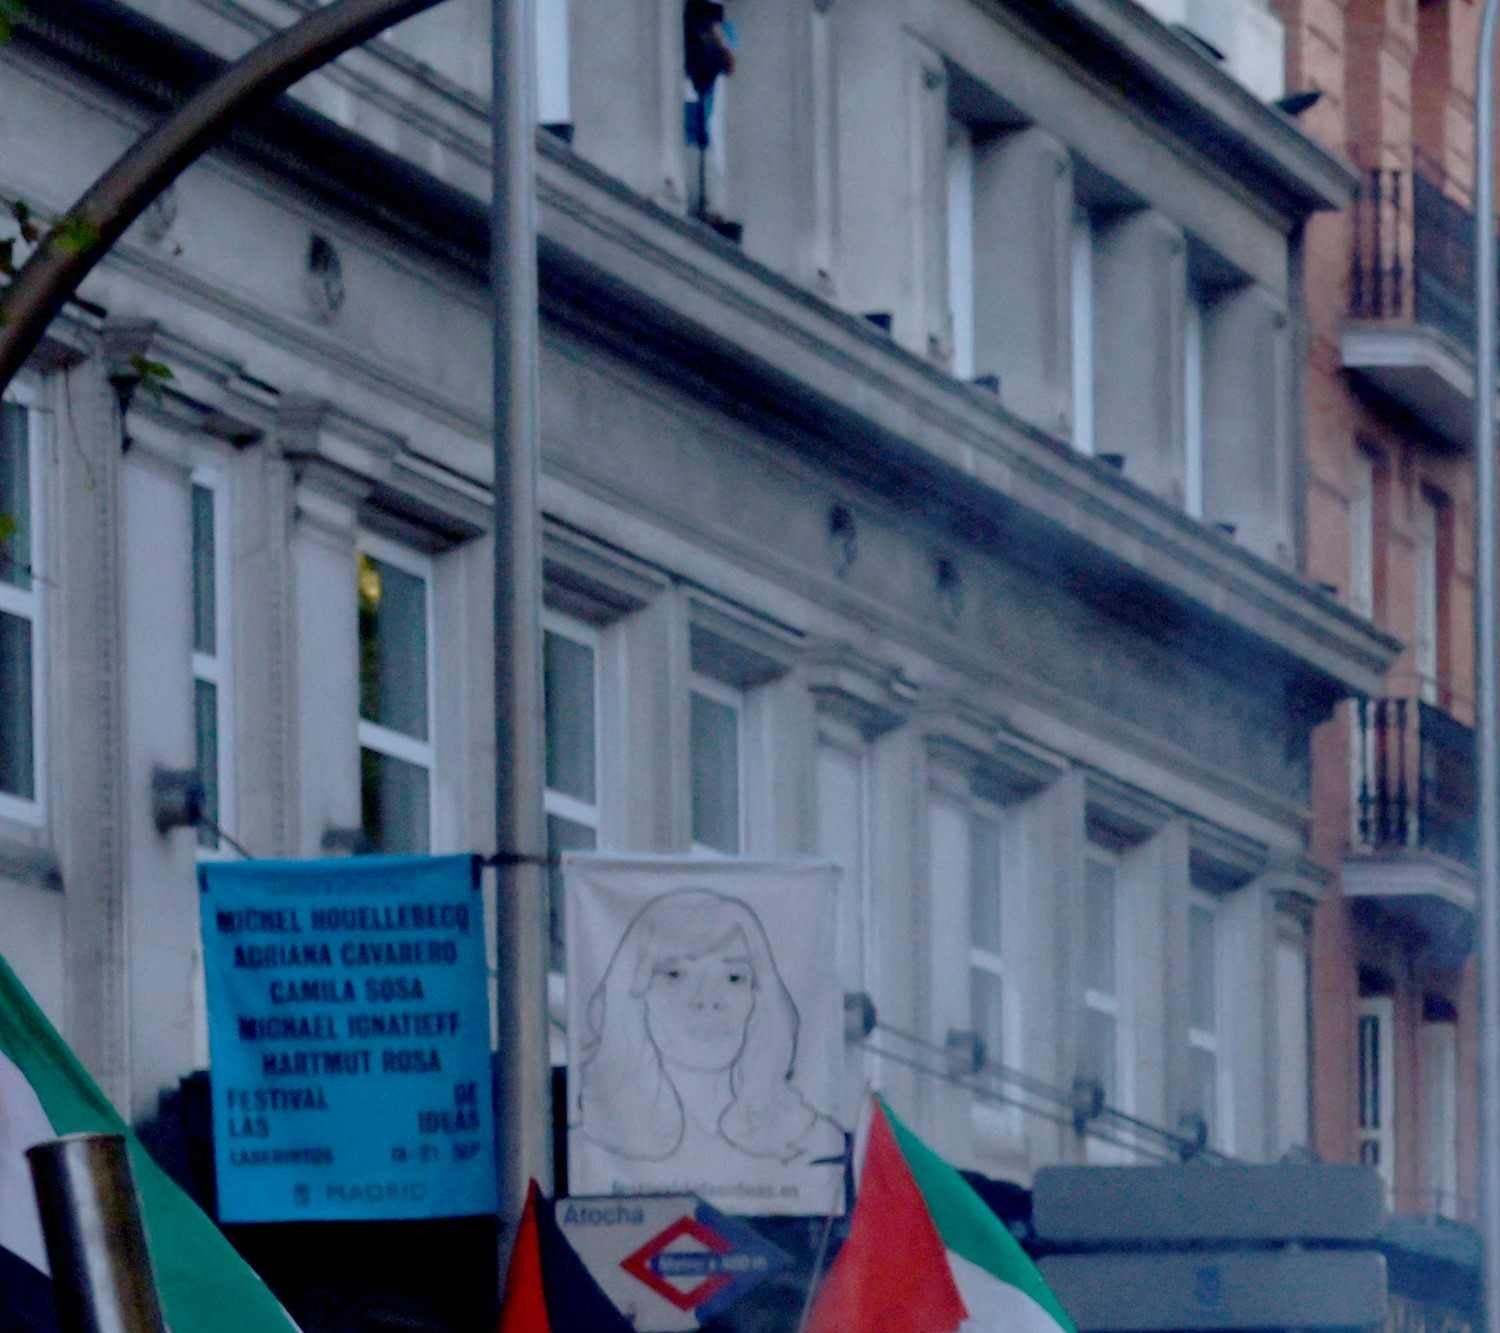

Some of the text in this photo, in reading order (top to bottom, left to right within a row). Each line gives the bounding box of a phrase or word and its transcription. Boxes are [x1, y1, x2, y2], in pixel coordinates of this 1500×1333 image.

[217, 911, 302, 934] MICHEL
[235, 943, 331, 969] ADRIANA
[270, 977, 424, 1004] CAMILA SOSA
[238, 1014, 337, 1041] MICHAEL
[263, 1049, 442, 1077] HARTMUT ROSA
[228, 1087, 328, 1110] FESTIVAL
[229, 1116, 269, 1139] LAS
[564, 1204, 644, 1226] Atocha
